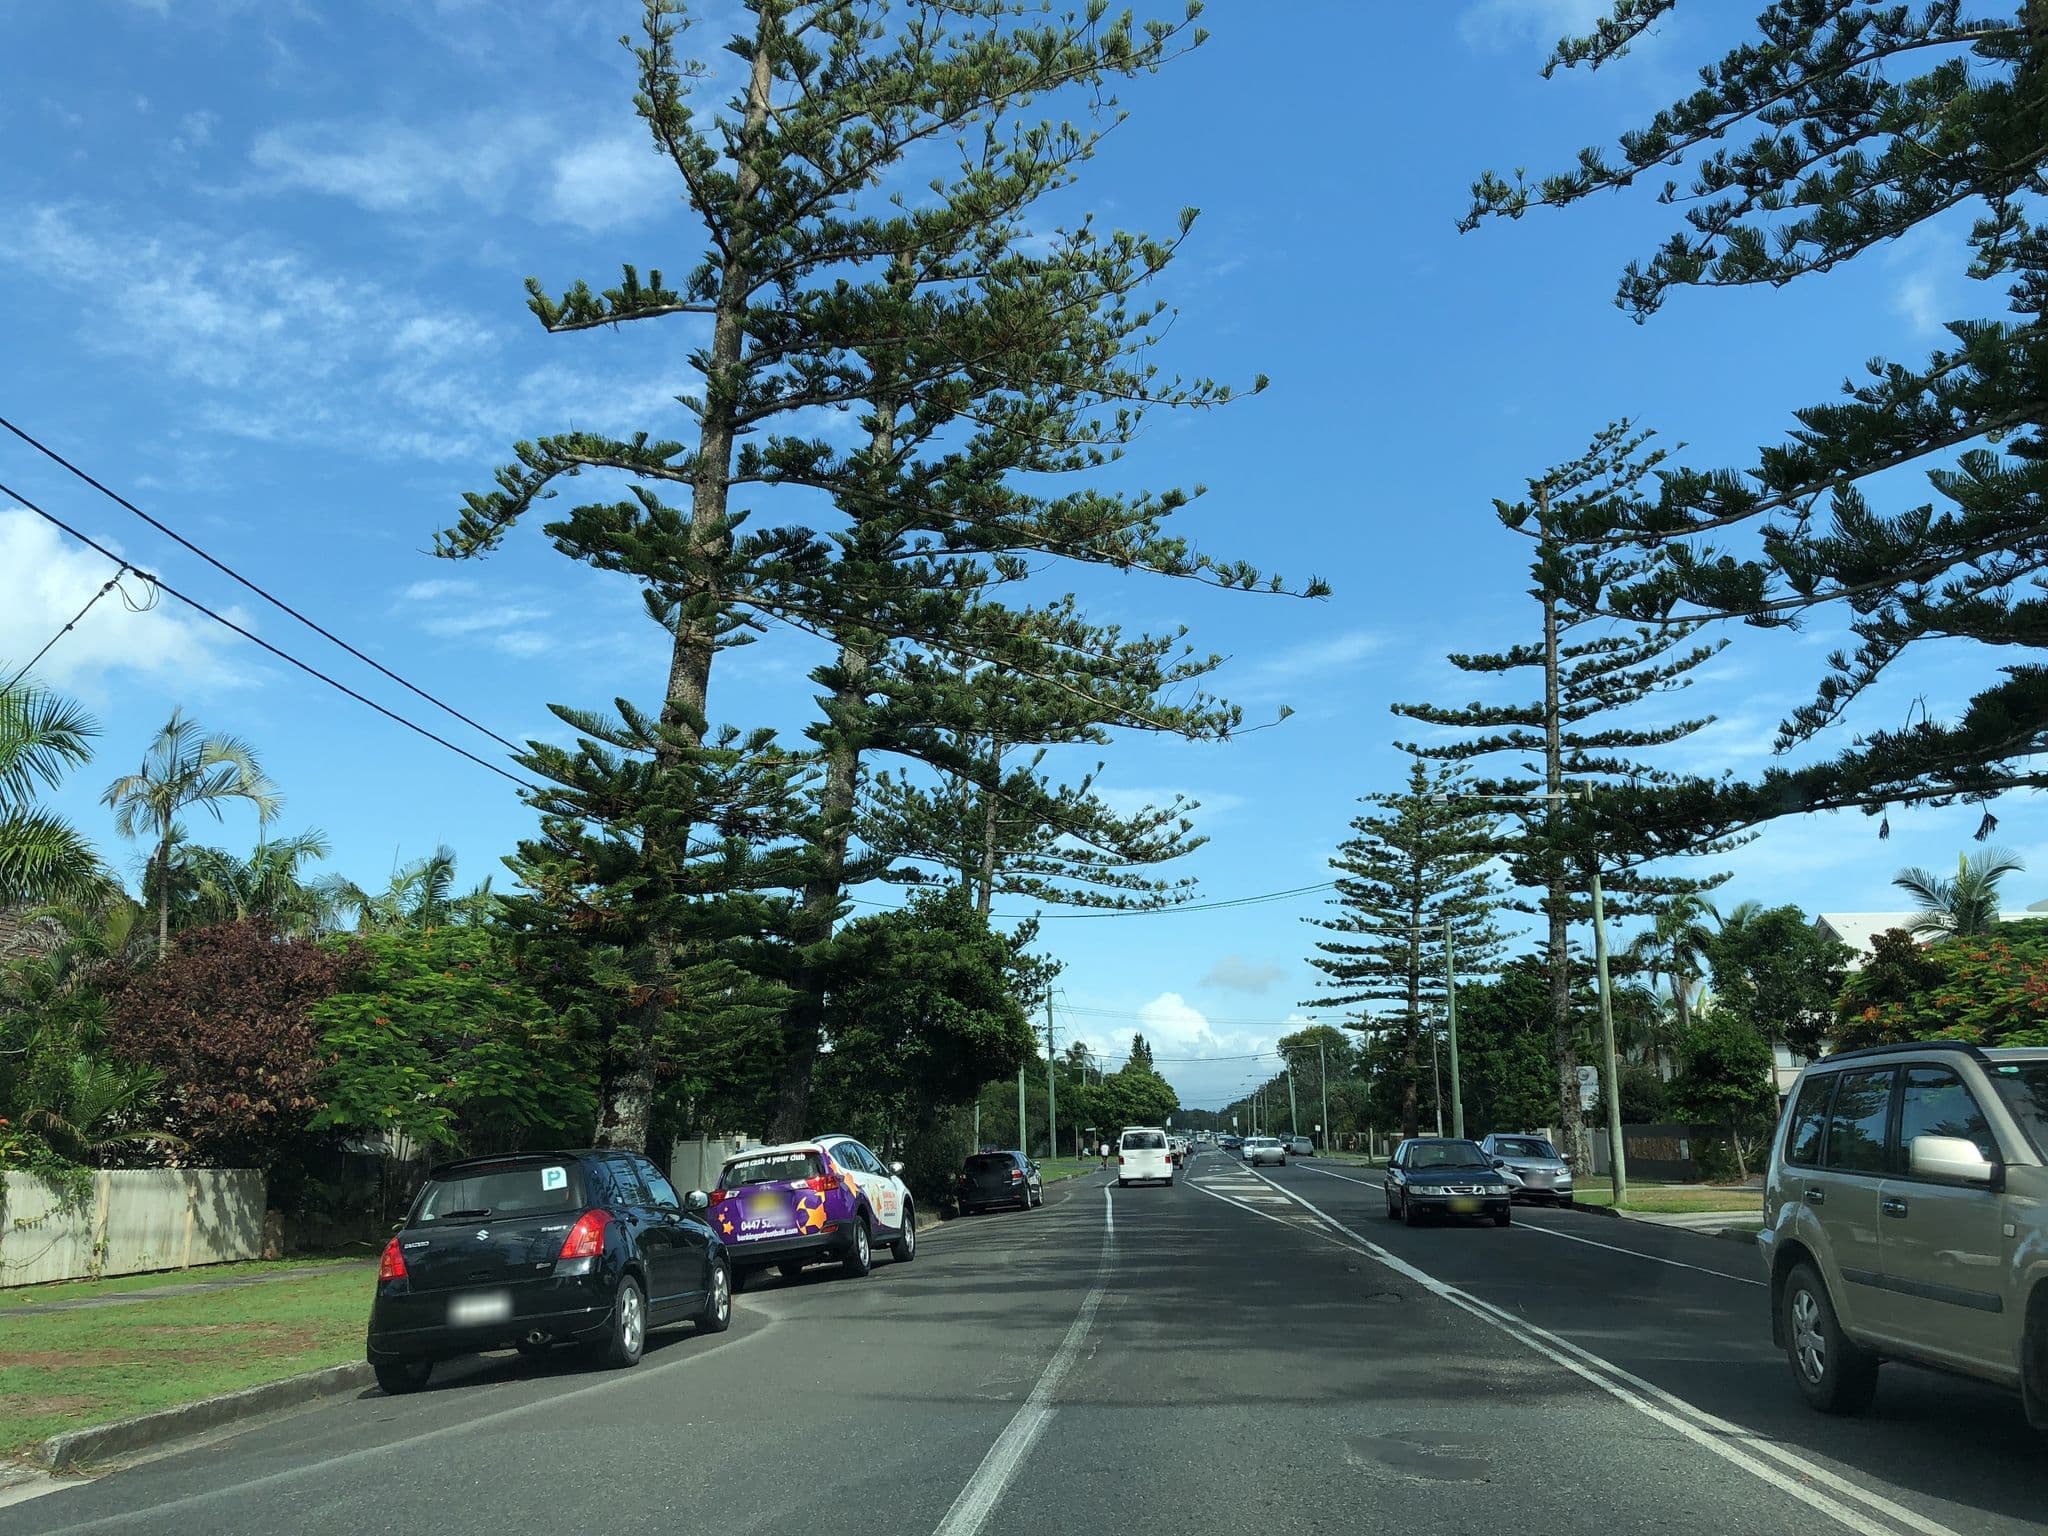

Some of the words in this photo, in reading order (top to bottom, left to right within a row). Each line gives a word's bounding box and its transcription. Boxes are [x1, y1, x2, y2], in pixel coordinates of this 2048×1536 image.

[750, 1158, 765, 1166] cash
[766, 1156, 771, 1164] 4
[772, 1156, 789, 1165] your
[790, 1153, 805, 1161] club
[547, 1170, 560, 1187] P
